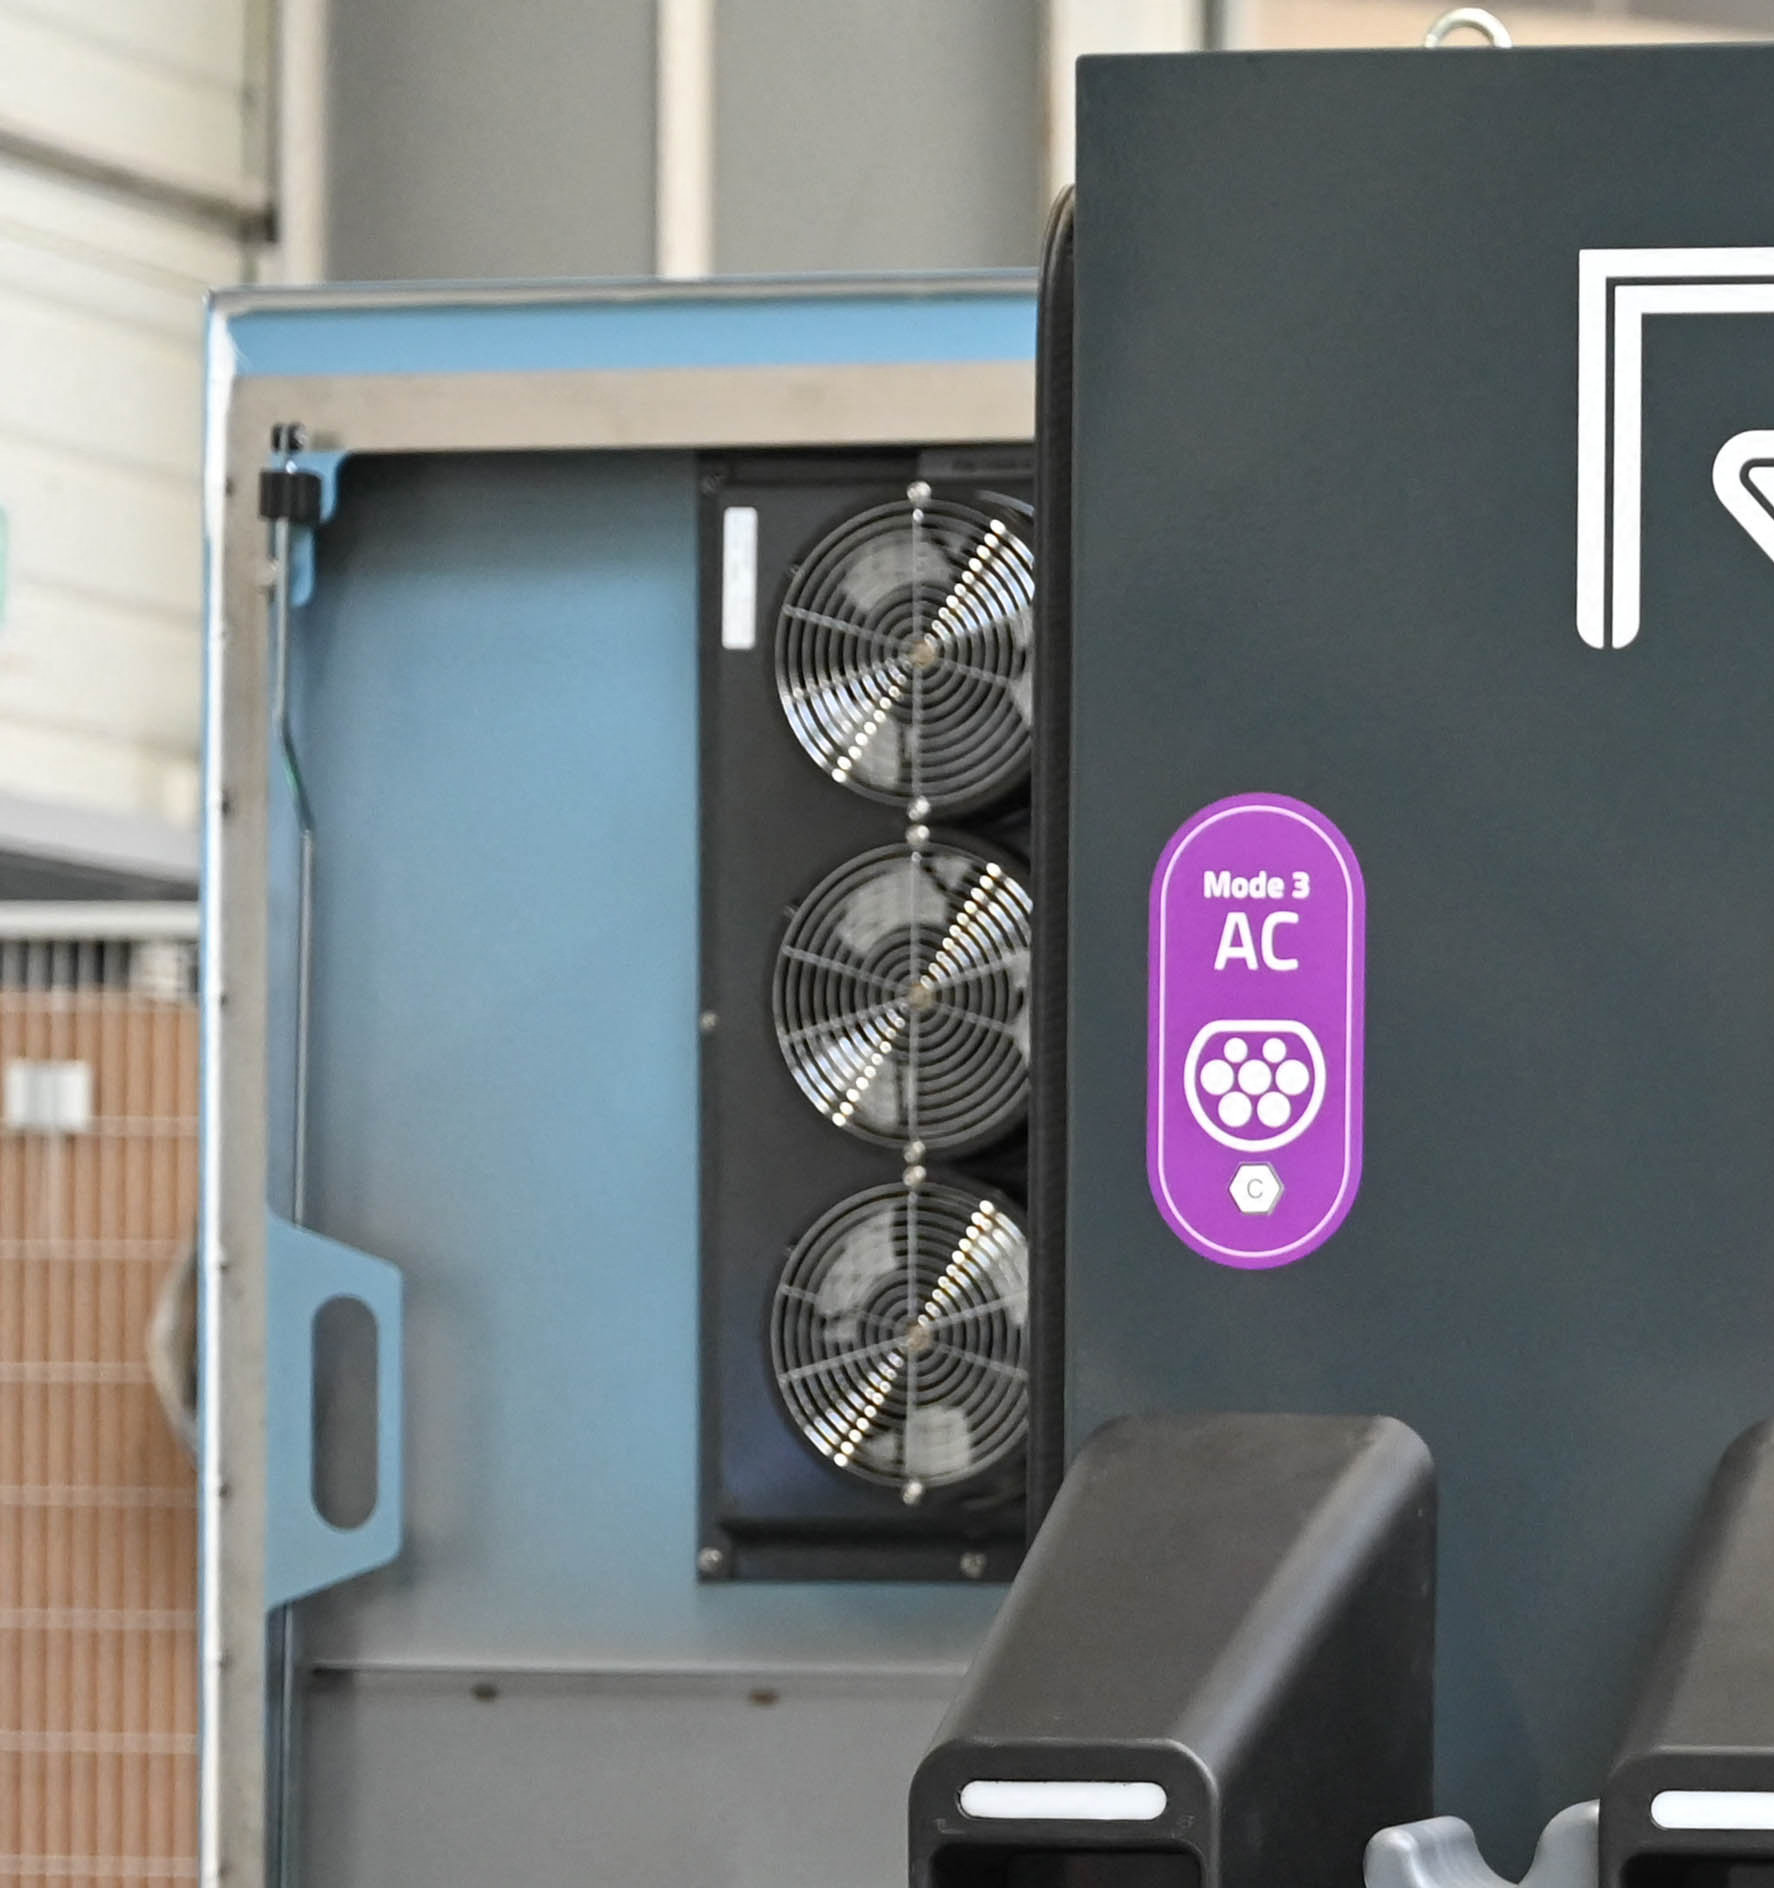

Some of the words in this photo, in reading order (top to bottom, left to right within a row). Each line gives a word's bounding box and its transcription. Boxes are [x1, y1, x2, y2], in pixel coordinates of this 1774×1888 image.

[1203, 870, 1285, 899] Mode
[1291, 871, 1310, 899] 3
[1213, 910, 1300, 971] AC
[1246, 1178, 1263, 1199] C
